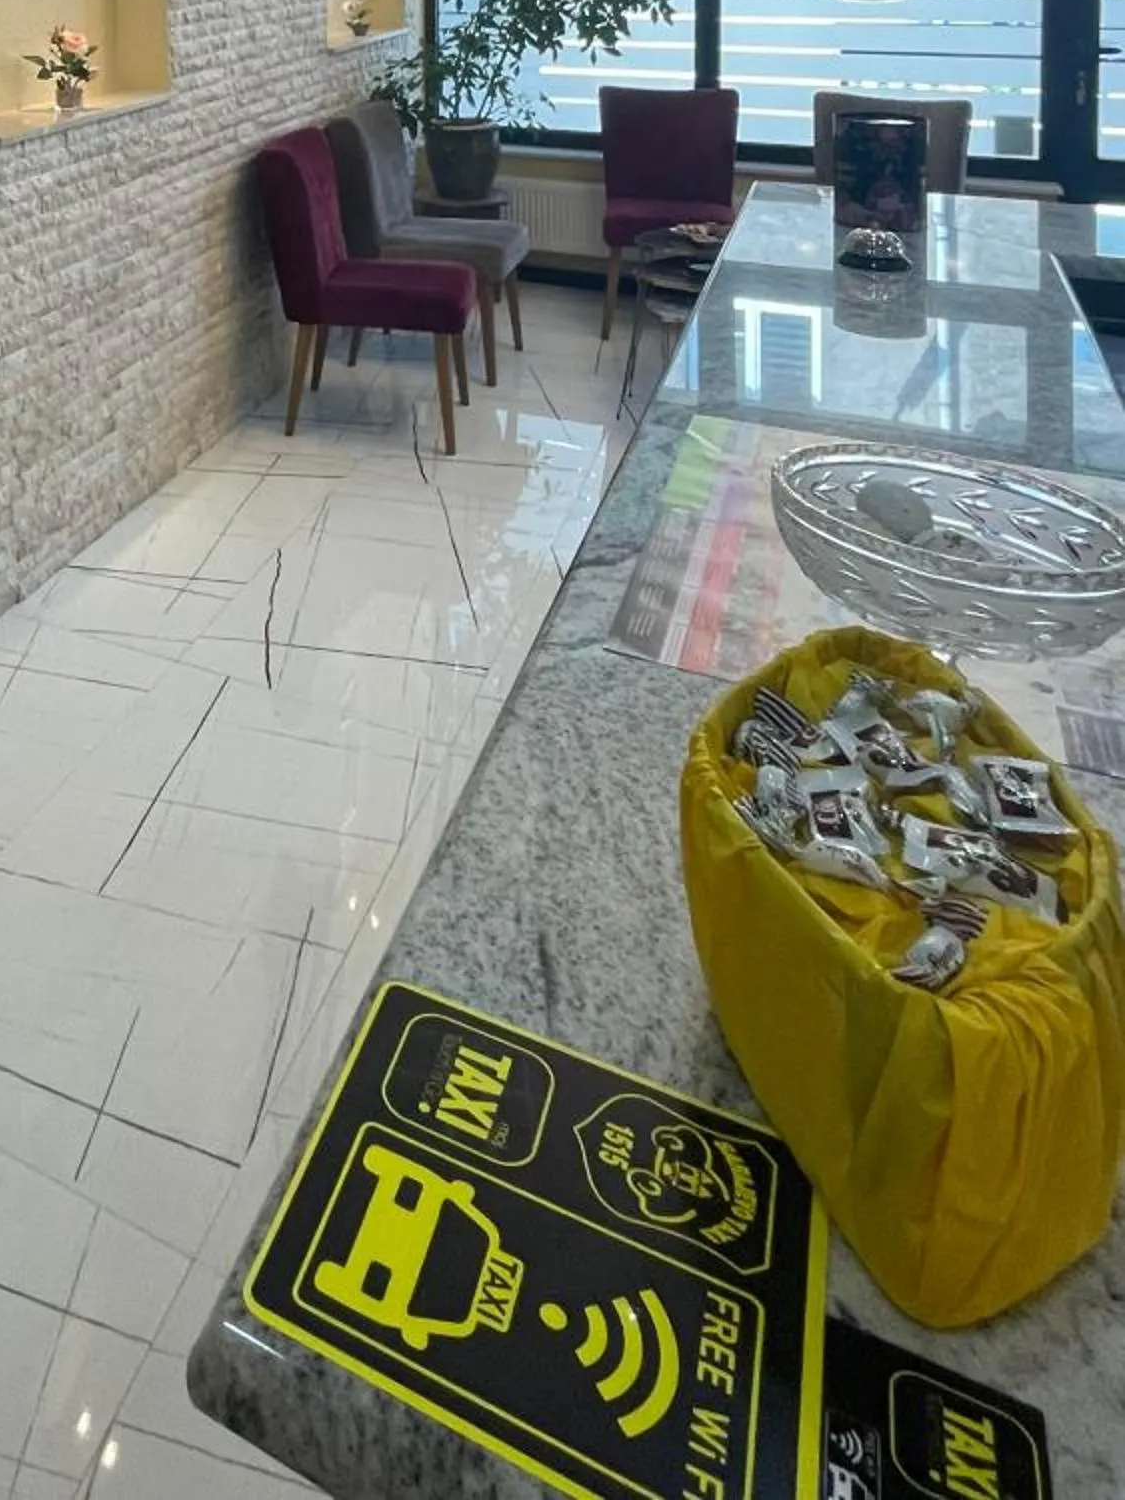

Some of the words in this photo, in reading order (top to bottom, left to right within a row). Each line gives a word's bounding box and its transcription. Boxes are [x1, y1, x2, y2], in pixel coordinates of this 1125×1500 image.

[435, 1045, 512, 1140] TAXI
[598, 1121, 635, 1171] 1515
[476, 1257, 518, 1325] TAXI
[696, 1291, 741, 1395] FREE
[942, 1406, 1000, 1500] TAXI
